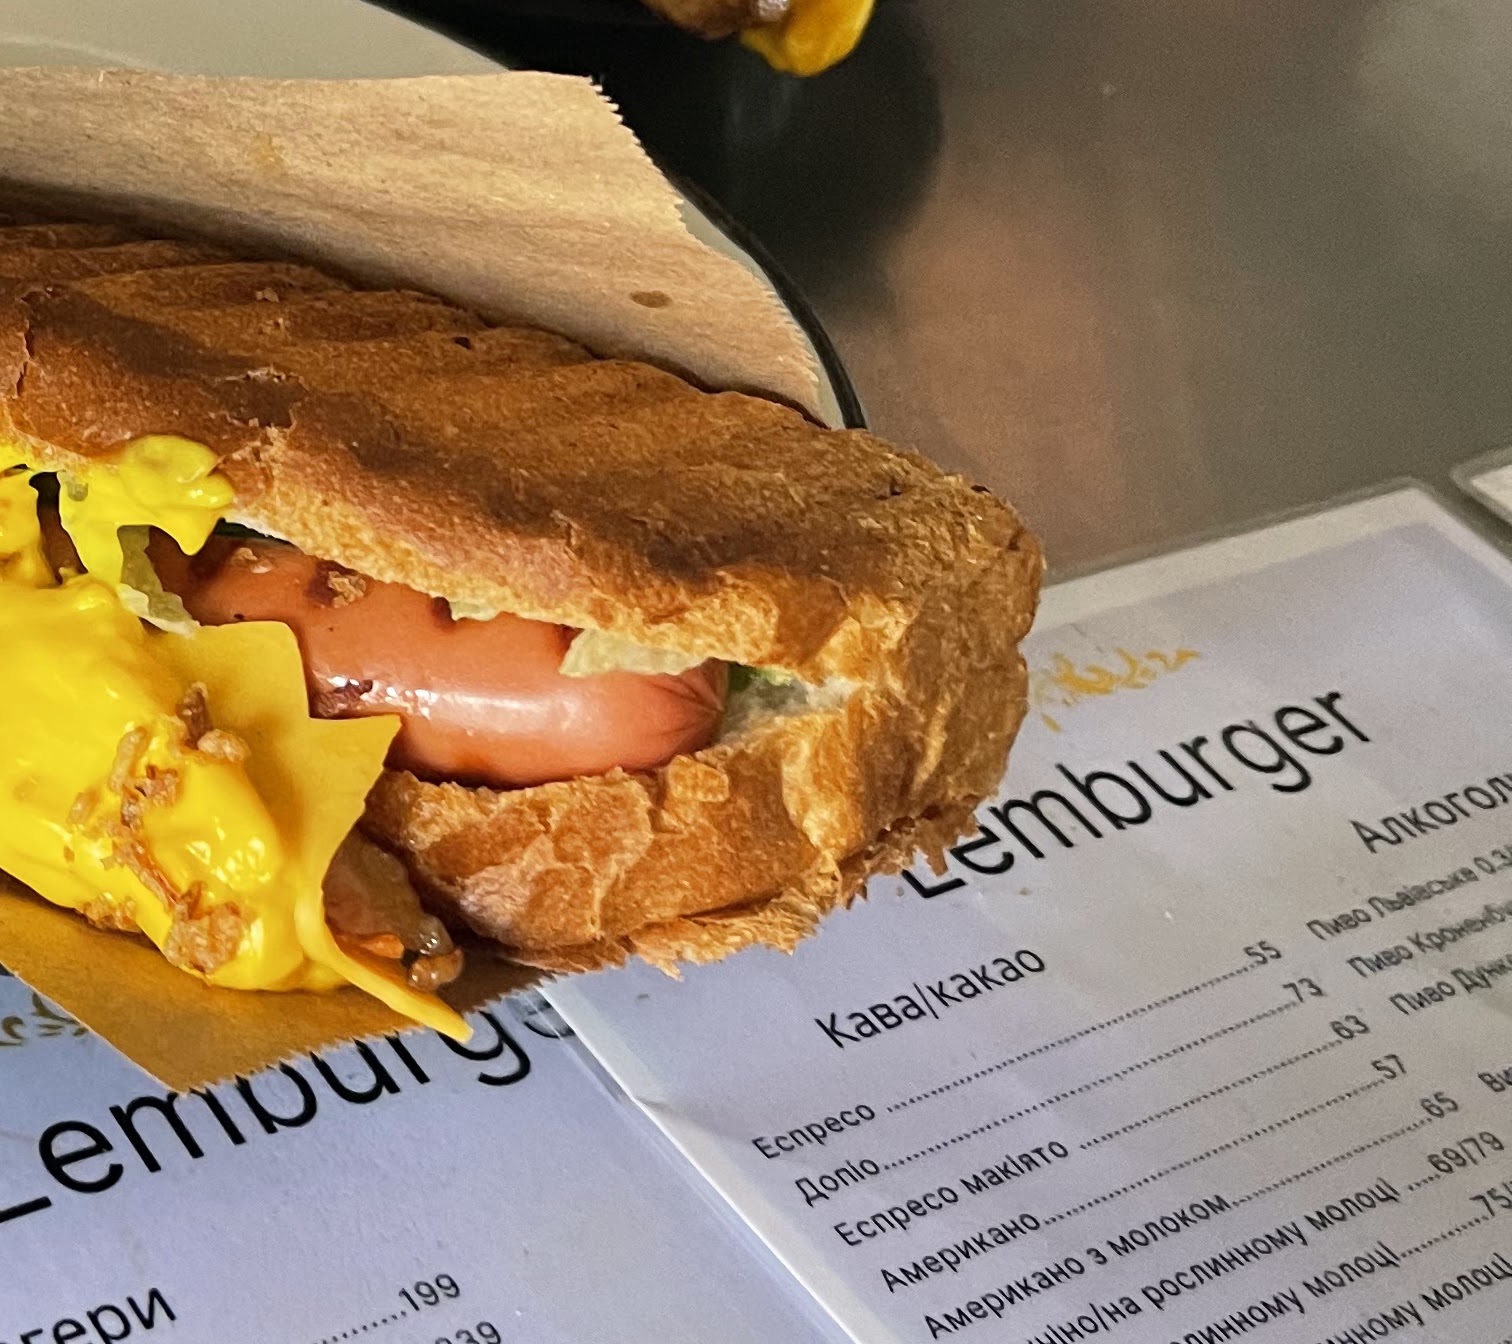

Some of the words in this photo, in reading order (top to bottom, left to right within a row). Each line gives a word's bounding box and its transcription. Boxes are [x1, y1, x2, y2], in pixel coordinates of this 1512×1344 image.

[1350, 773, 1512, 853] Алкогол
[1307, 909, 1371, 940] Пиво
[1347, 945, 1413, 977] Пиво
[815, 945, 1046, 1049] Кава/какао
[1390, 981, 1455, 1015] Пиво
[752, 1103, 876, 1160] Еспресо
[1243, 940, 1281, 965] 55
[795, 1158, 880, 1207] Допіо
[1283, 977, 1324, 1003] 73
[833, 1185, 959, 1247] Еспресо
[960, 1140, 1068, 1196] макіято
[1329, 1014, 1370, 1039] 63
[880, 1212, 1040, 1293] Американо
[1372, 1054, 1406, 1079] 57
[924, 1255, 1086, 1340] Американо
[1087, 1246, 1107, 1266] з
[1107, 1193, 1232, 1258] молоком
[1420, 1092, 1458, 1118] 65
[1142, 1218, 1307, 1311] рослинному
[1306, 1177, 1400, 1233] молоці
[399, 1273, 461, 1312] 199
[1302, 1240, 1401, 1300] молоці
[1423, 1252, 1512, 1311] молоці
